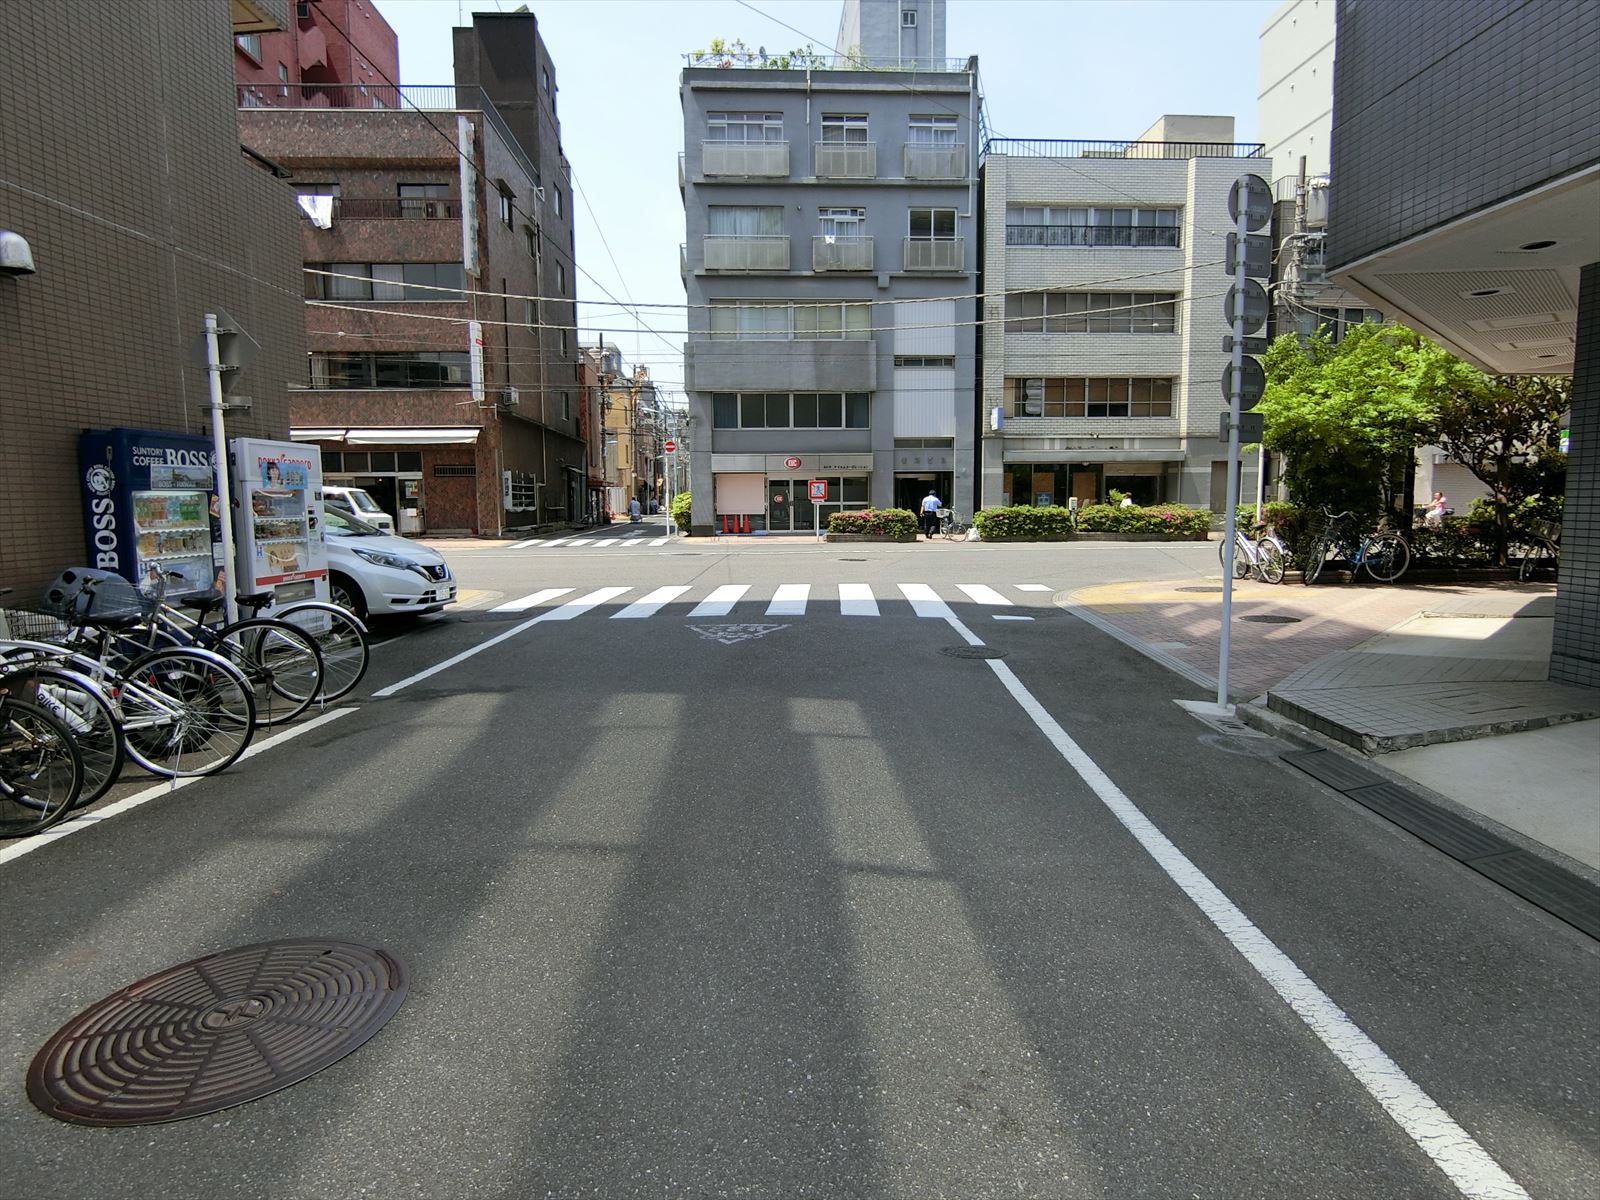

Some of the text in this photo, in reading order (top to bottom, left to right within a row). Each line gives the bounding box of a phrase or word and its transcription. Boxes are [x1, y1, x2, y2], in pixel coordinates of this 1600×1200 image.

[132, 446, 164, 456] SUNTORY
[165, 448, 208, 467] BOSS
[91, 497, 119, 570] BOSS
